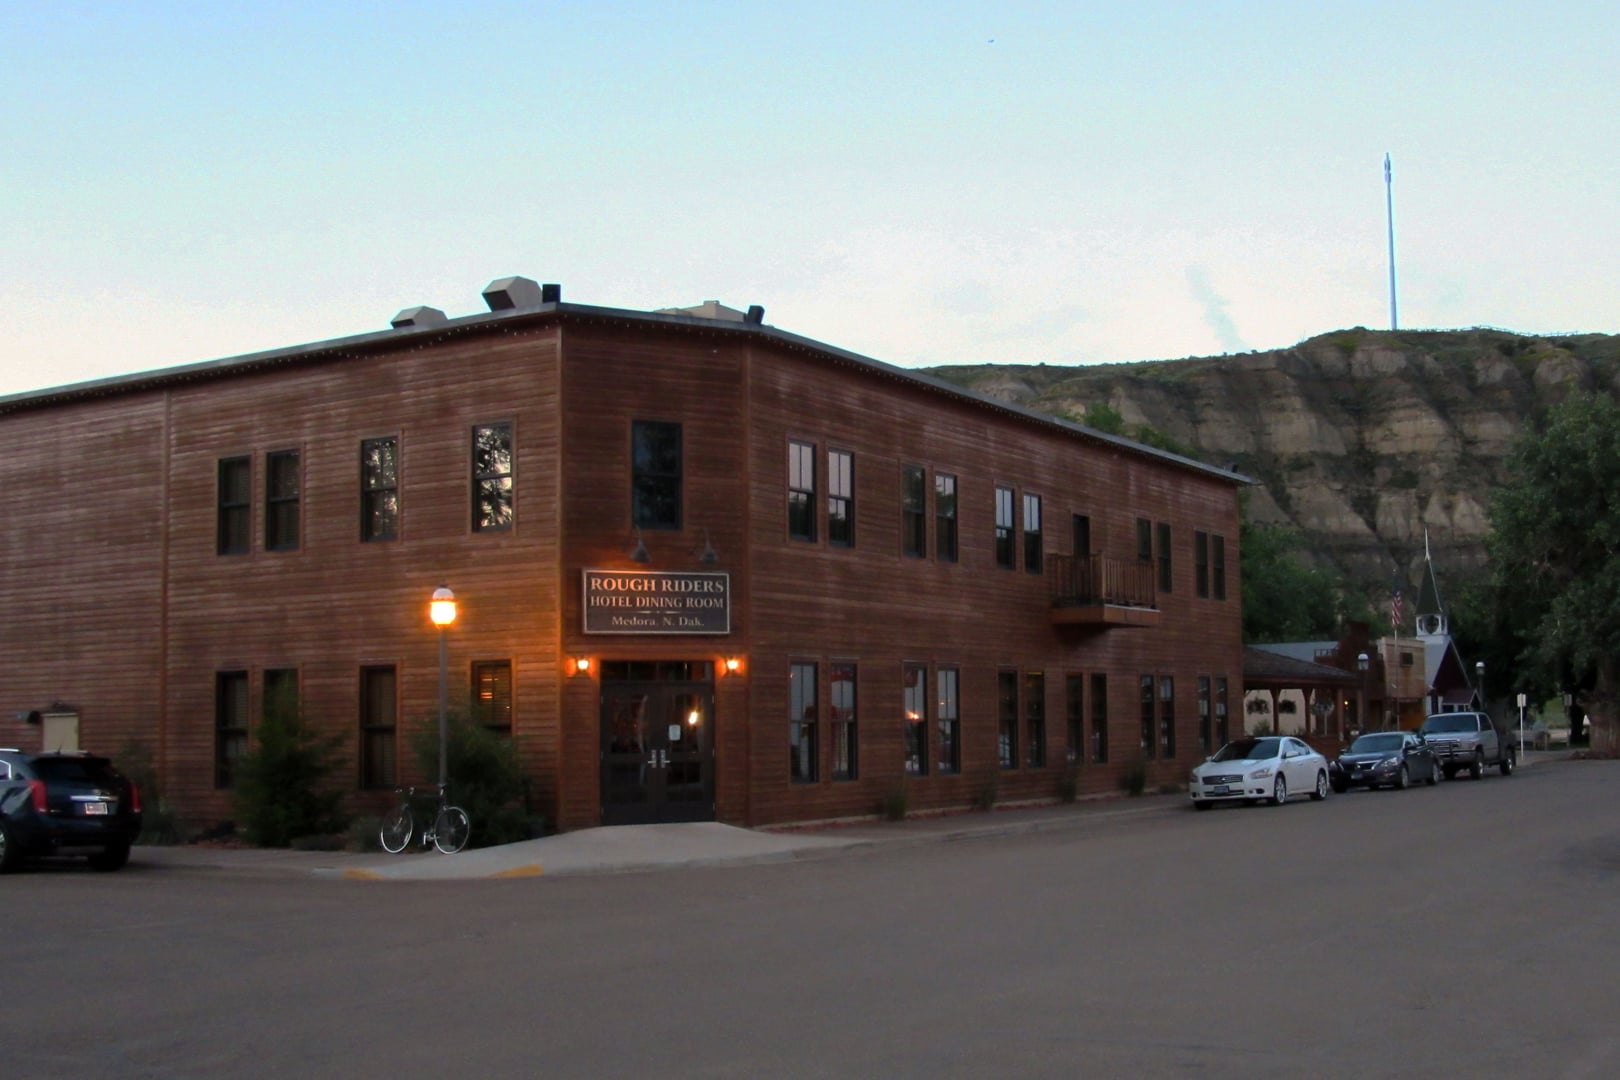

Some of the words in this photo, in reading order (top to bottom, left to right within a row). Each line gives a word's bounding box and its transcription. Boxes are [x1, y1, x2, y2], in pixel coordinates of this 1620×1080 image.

[591, 577, 656, 592] ROUGH
[662, 579, 724, 593] RIDERS
[590, 595, 632, 608] HOTEL
[636, 596, 682, 608] DINING
[686, 597, 724, 609] ROOM
[679, 616, 705, 627] Dak.
